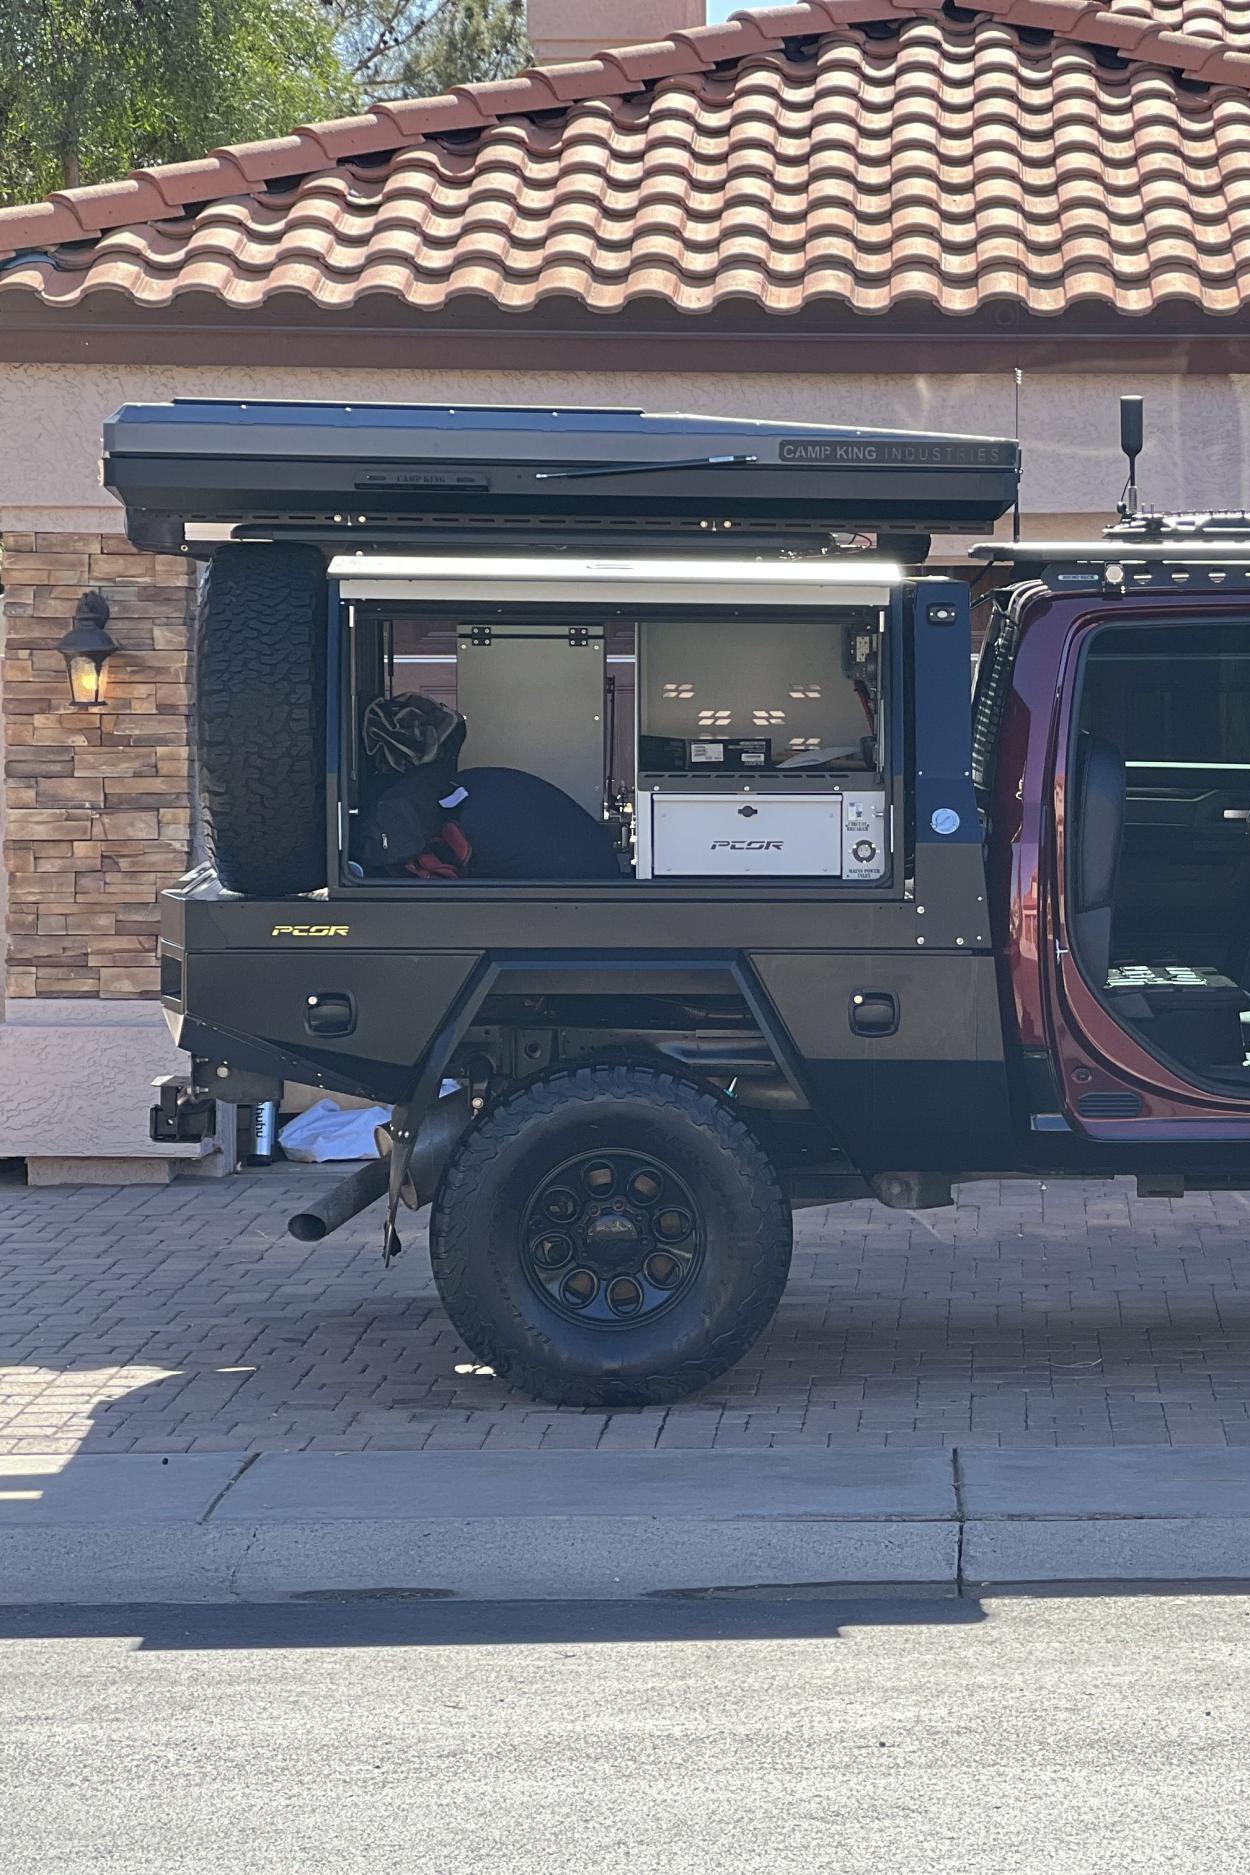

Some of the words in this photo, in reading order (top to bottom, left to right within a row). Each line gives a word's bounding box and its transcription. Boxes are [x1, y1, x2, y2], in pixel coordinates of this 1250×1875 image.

[783, 445, 831, 459] CAMP
[836, 446, 877, 460] KING
[884, 447, 1000, 462] INDUSTRIES
